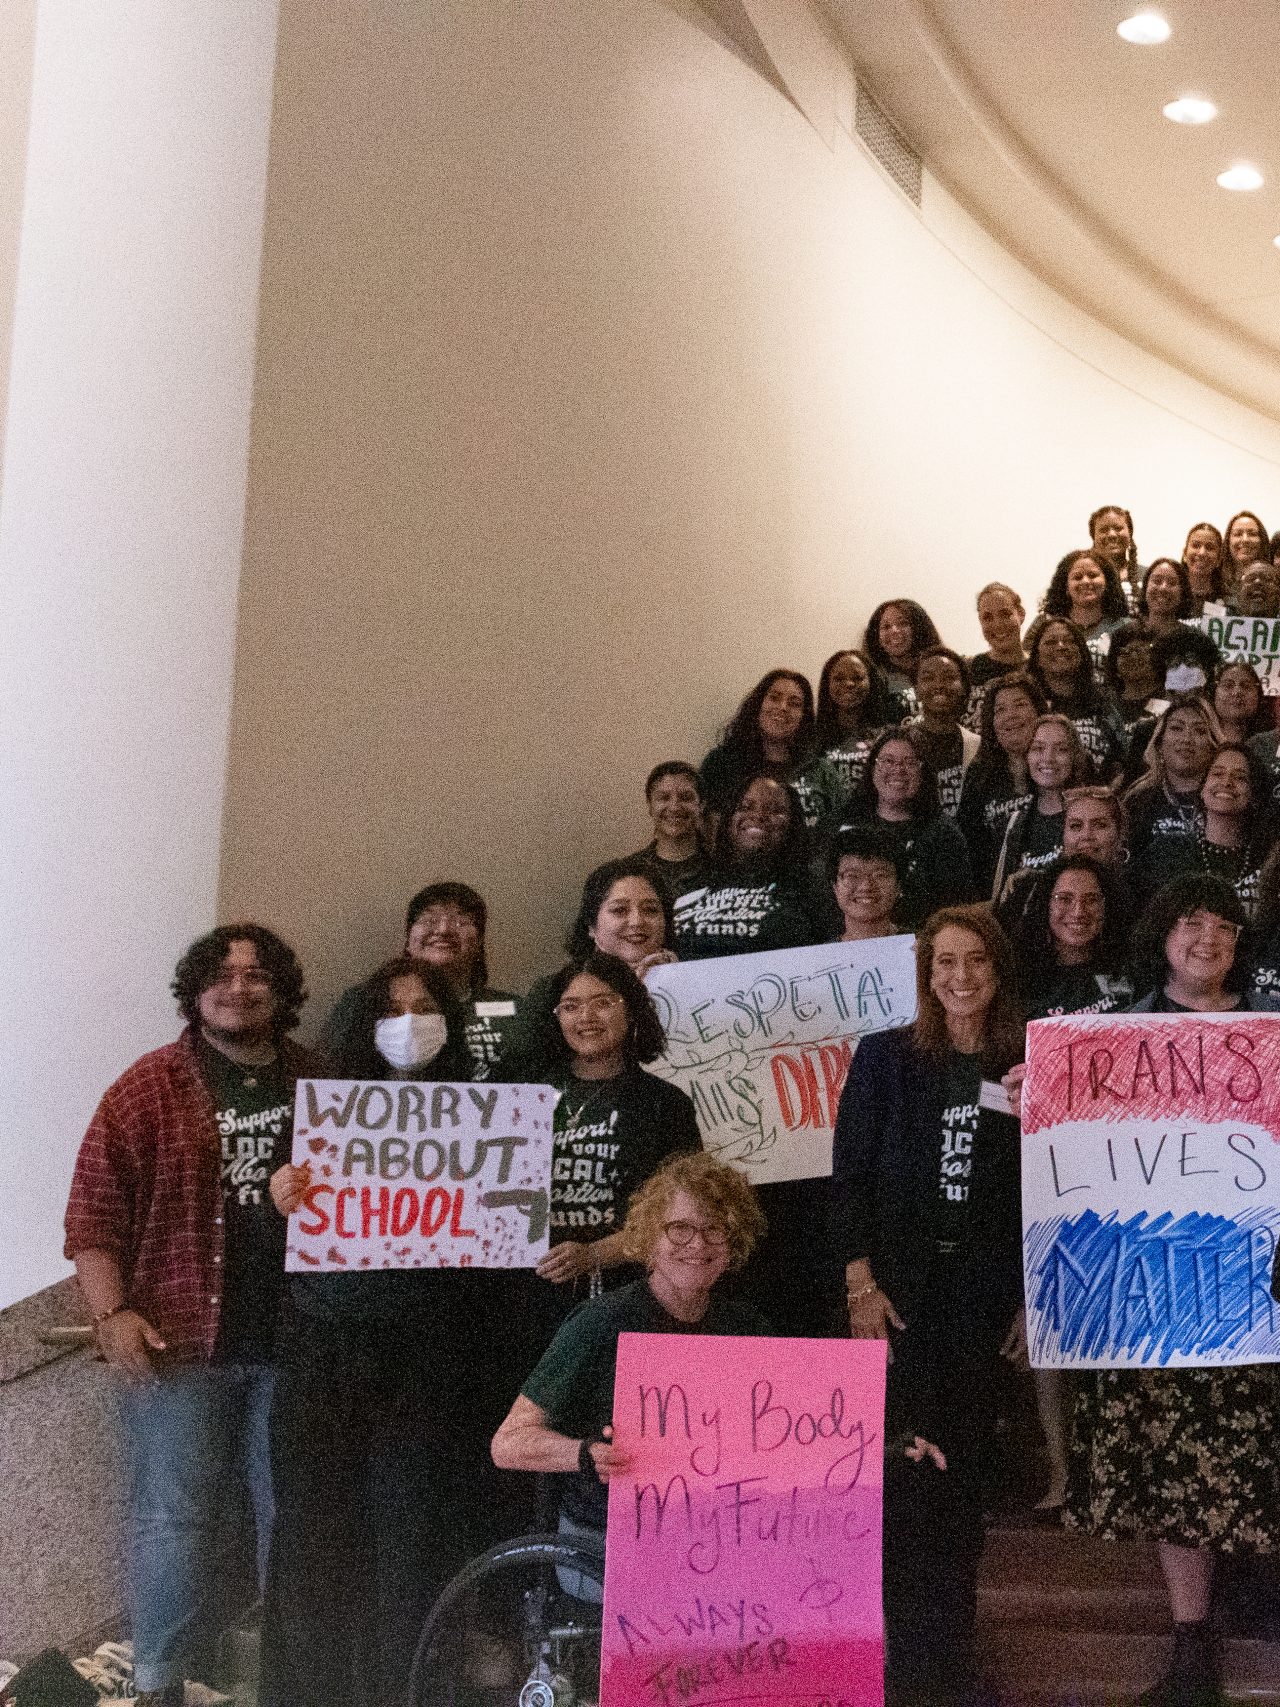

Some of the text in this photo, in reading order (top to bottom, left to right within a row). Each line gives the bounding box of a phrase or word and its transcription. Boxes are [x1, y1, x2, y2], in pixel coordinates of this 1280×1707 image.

[694, 921, 761, 938] funds
[1049, 1031, 1263, 1111] TRANS
[304, 1081, 498, 1132] WORRY
[341, 1136, 529, 1184] ABOUT
[1049, 1131, 1267, 1197] LIVES
[299, 1183, 478, 1239] SCHOOL
[1045, 1222, 1276, 1335] MATTER
[751, 1379, 877, 1496] Body
[616, 1598, 774, 1656] ALWAYS
